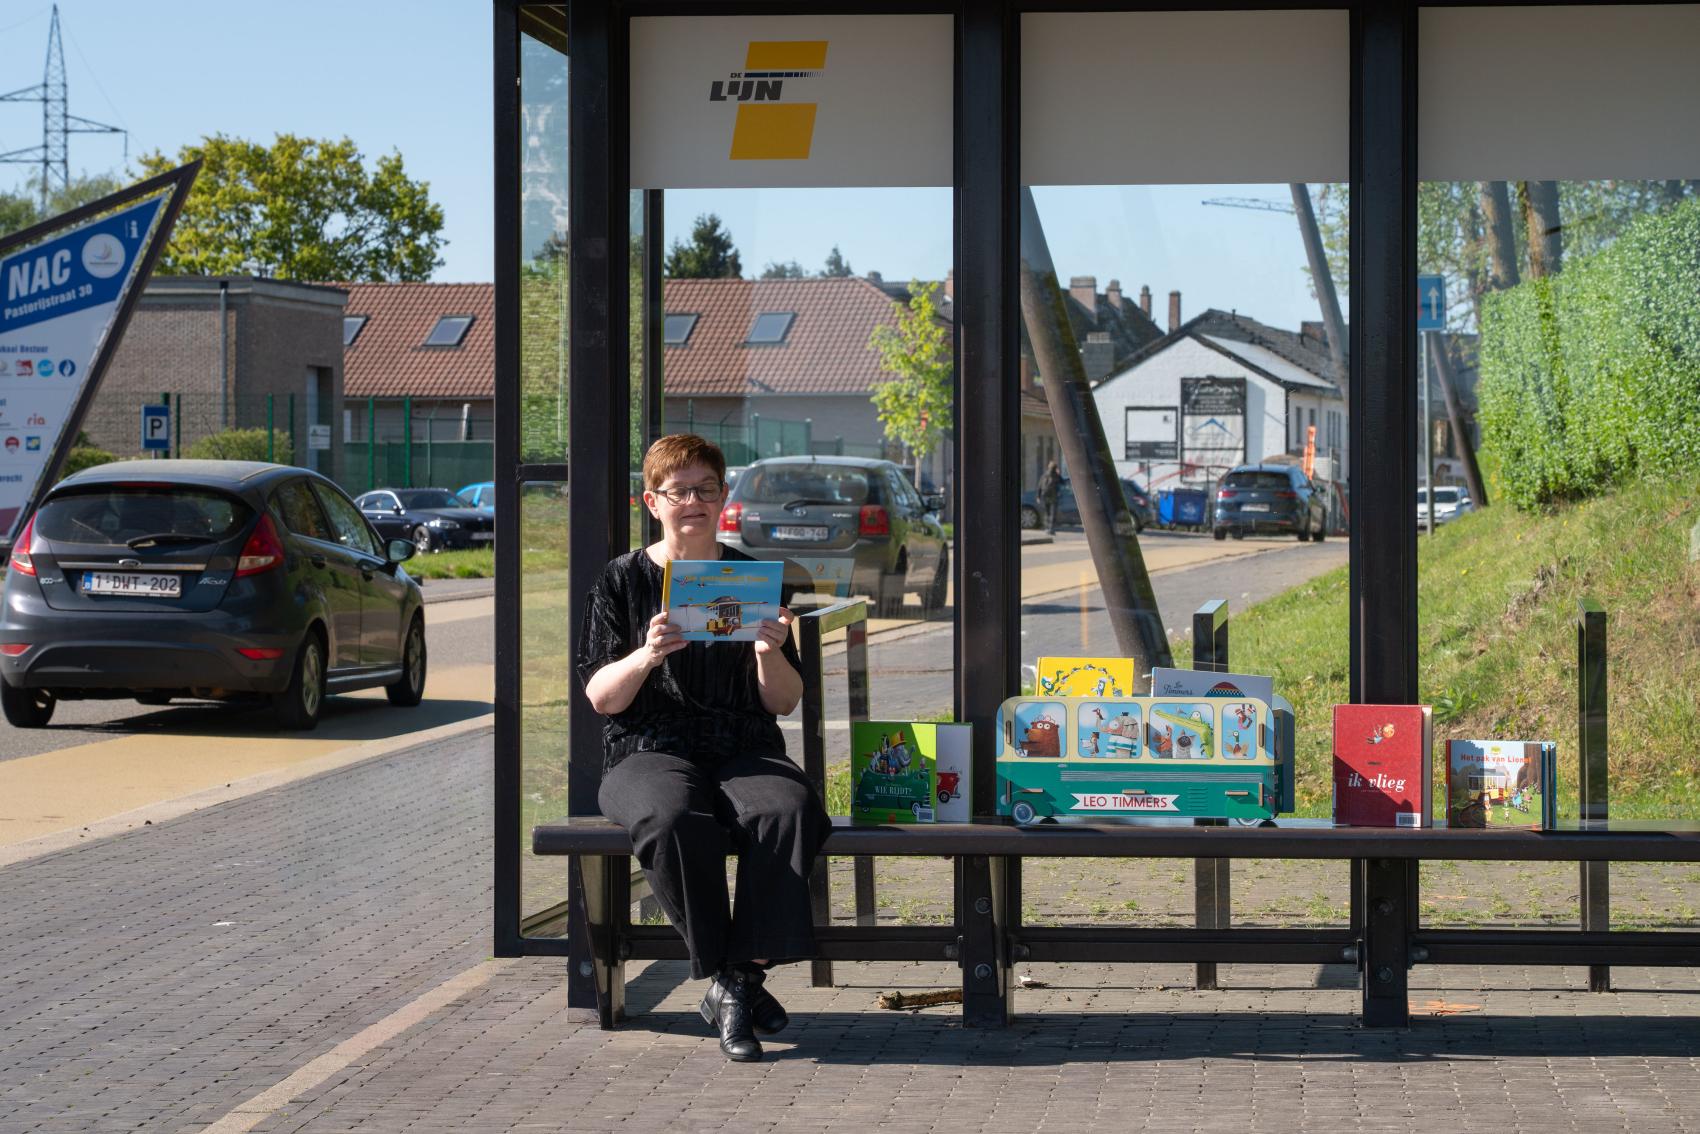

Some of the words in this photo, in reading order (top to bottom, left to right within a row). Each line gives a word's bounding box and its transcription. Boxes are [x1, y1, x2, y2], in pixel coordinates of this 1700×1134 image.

[710, 80, 783, 101] LIJN
[8, 249, 71, 301] NAC
[4, 289, 77, 320] Pastorijstraat
[78, 283, 93, 299] 30
[150, 417, 163, 438] P
[1476, 755, 1489, 763] pak
[1348, 773, 1362, 787] ik
[1368, 773, 1406, 793] vlieg
[1083, 796, 1107, 807] LEO
[1112, 797, 1168, 808] TIMMERS
